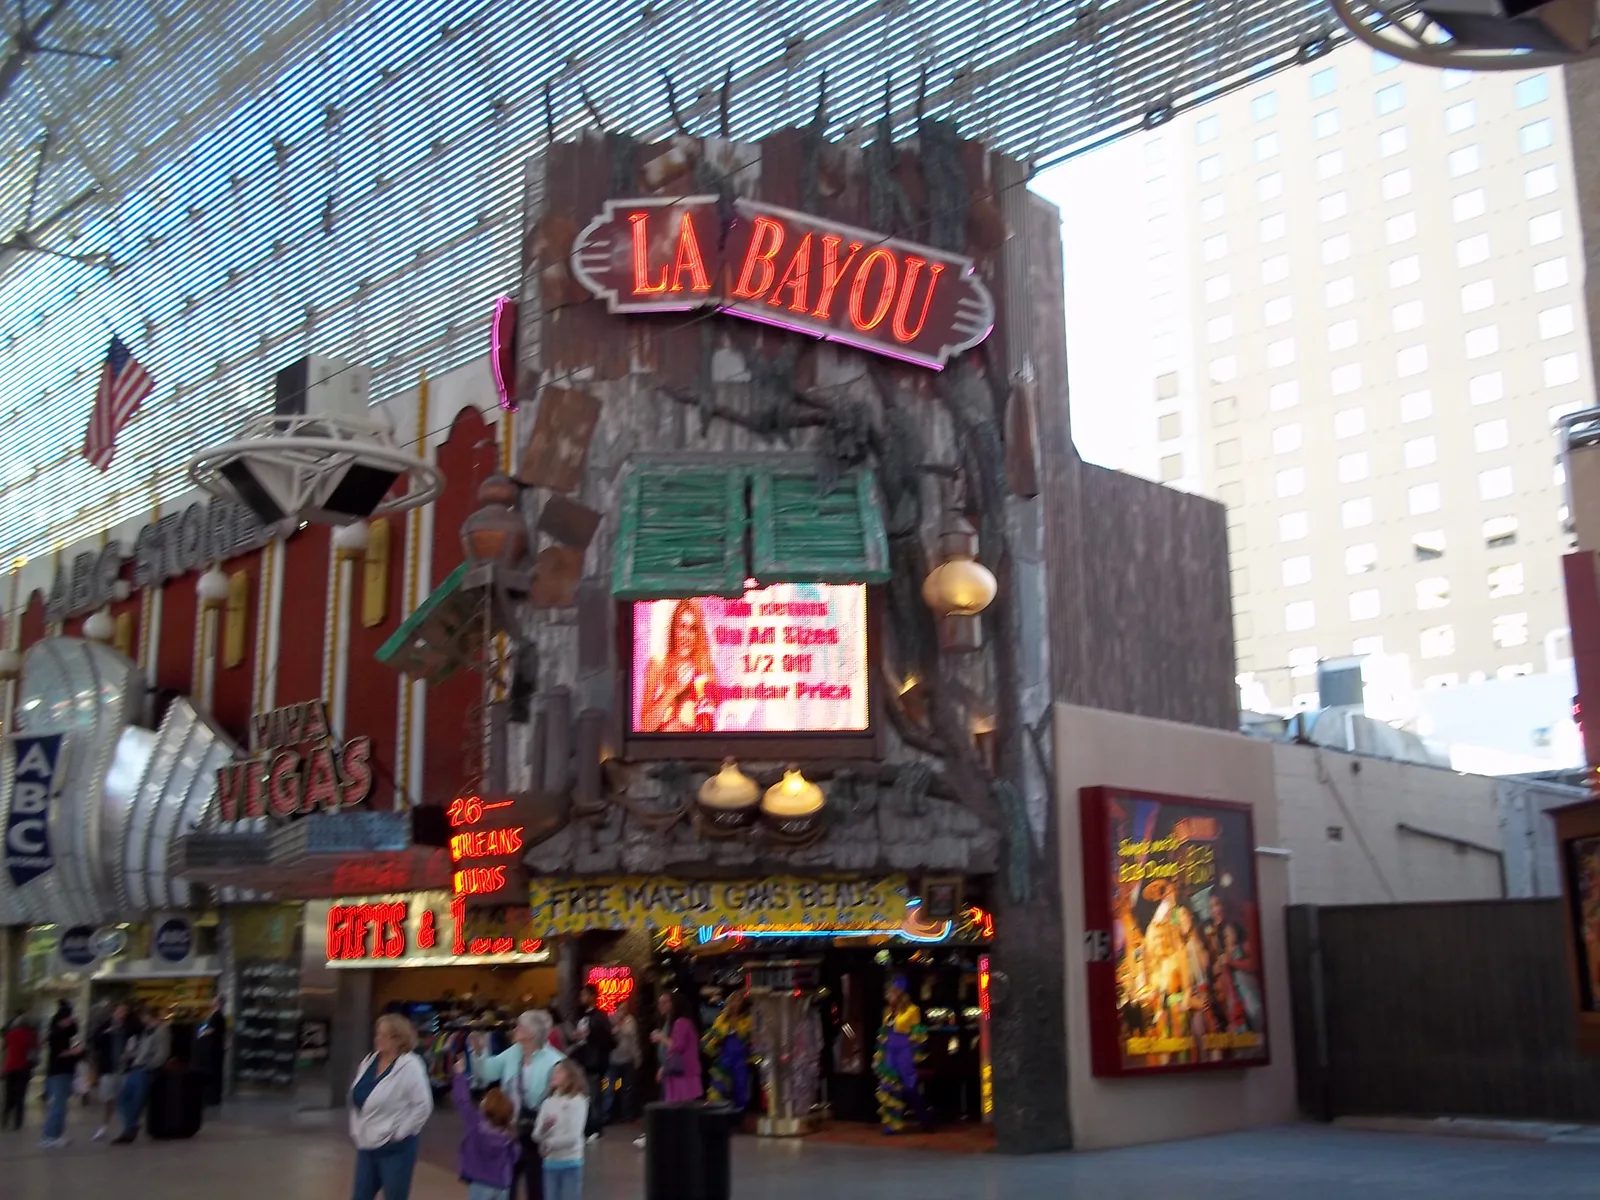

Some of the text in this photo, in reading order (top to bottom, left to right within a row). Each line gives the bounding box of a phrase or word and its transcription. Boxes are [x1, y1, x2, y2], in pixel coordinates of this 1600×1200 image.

[628, 212, 946, 343] LA BAYOU
[743, 653, 812, 673] 1/2 Off
[749, 626, 775, 645] All
[783, 626, 839, 646] Sizes
[254, 699, 328, 750] VIVA
[10, 742, 51, 854] ABC
[217, 735, 373, 822] VEGAS
[550, 881, 613, 920] FREE
[622, 878, 714, 914] MARDI
[325, 901, 406, 961] GIFTS
[415, 910, 435, 949] &
